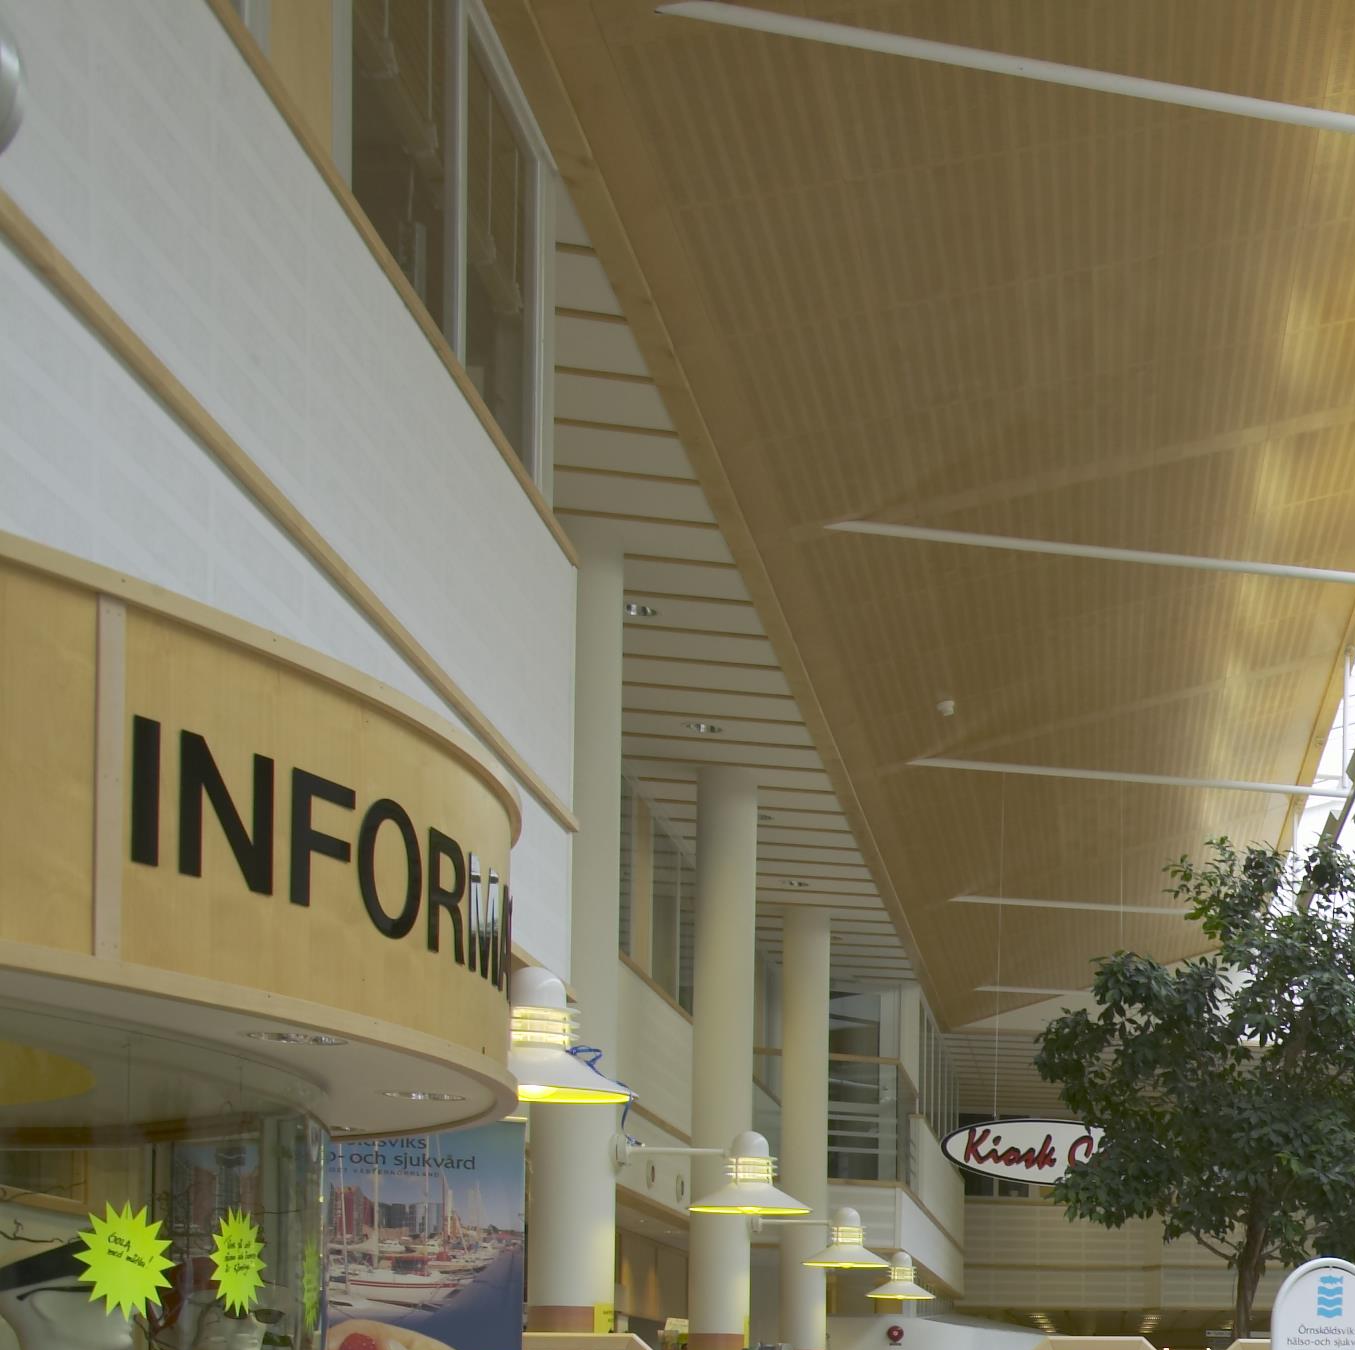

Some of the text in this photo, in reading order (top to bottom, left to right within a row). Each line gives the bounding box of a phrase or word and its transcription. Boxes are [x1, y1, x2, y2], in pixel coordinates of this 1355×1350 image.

[964, 1127, 1057, 1171] Kiosk
[350, 1151, 386, 1165] och
[393, 1152, 476, 1170] sjukvård
[1287, 1337, 1330, 1346] hälso-och
